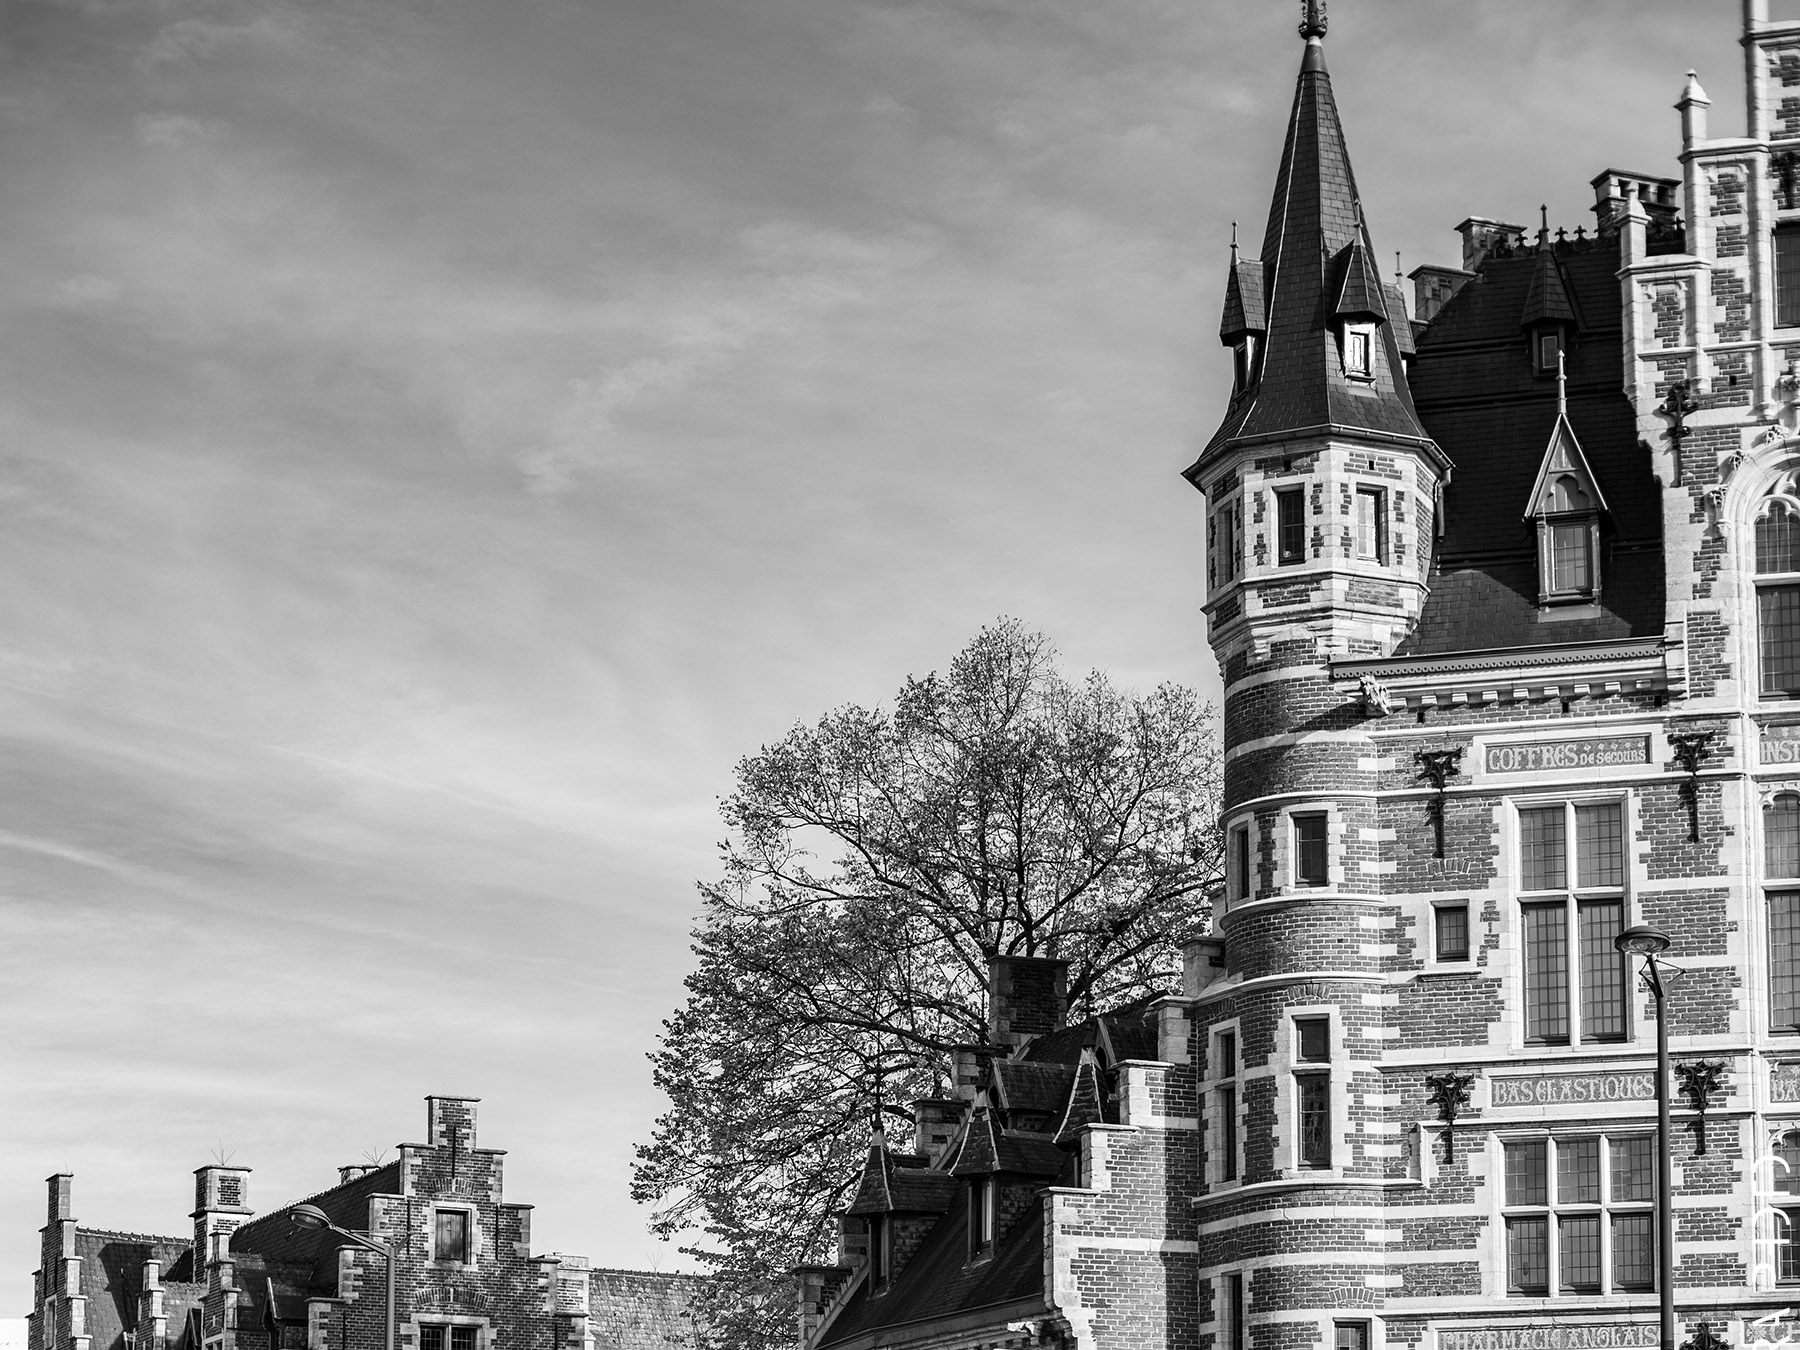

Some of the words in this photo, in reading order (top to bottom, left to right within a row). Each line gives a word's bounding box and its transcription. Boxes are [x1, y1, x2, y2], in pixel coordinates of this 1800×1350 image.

[1488, 743, 1579, 771] COFFRES
[1492, 1080, 1534, 1105] BAS
[1535, 1074, 1656, 1103] ELASTIQUES
[1566, 1324, 1661, 1348] ANGLAIS
